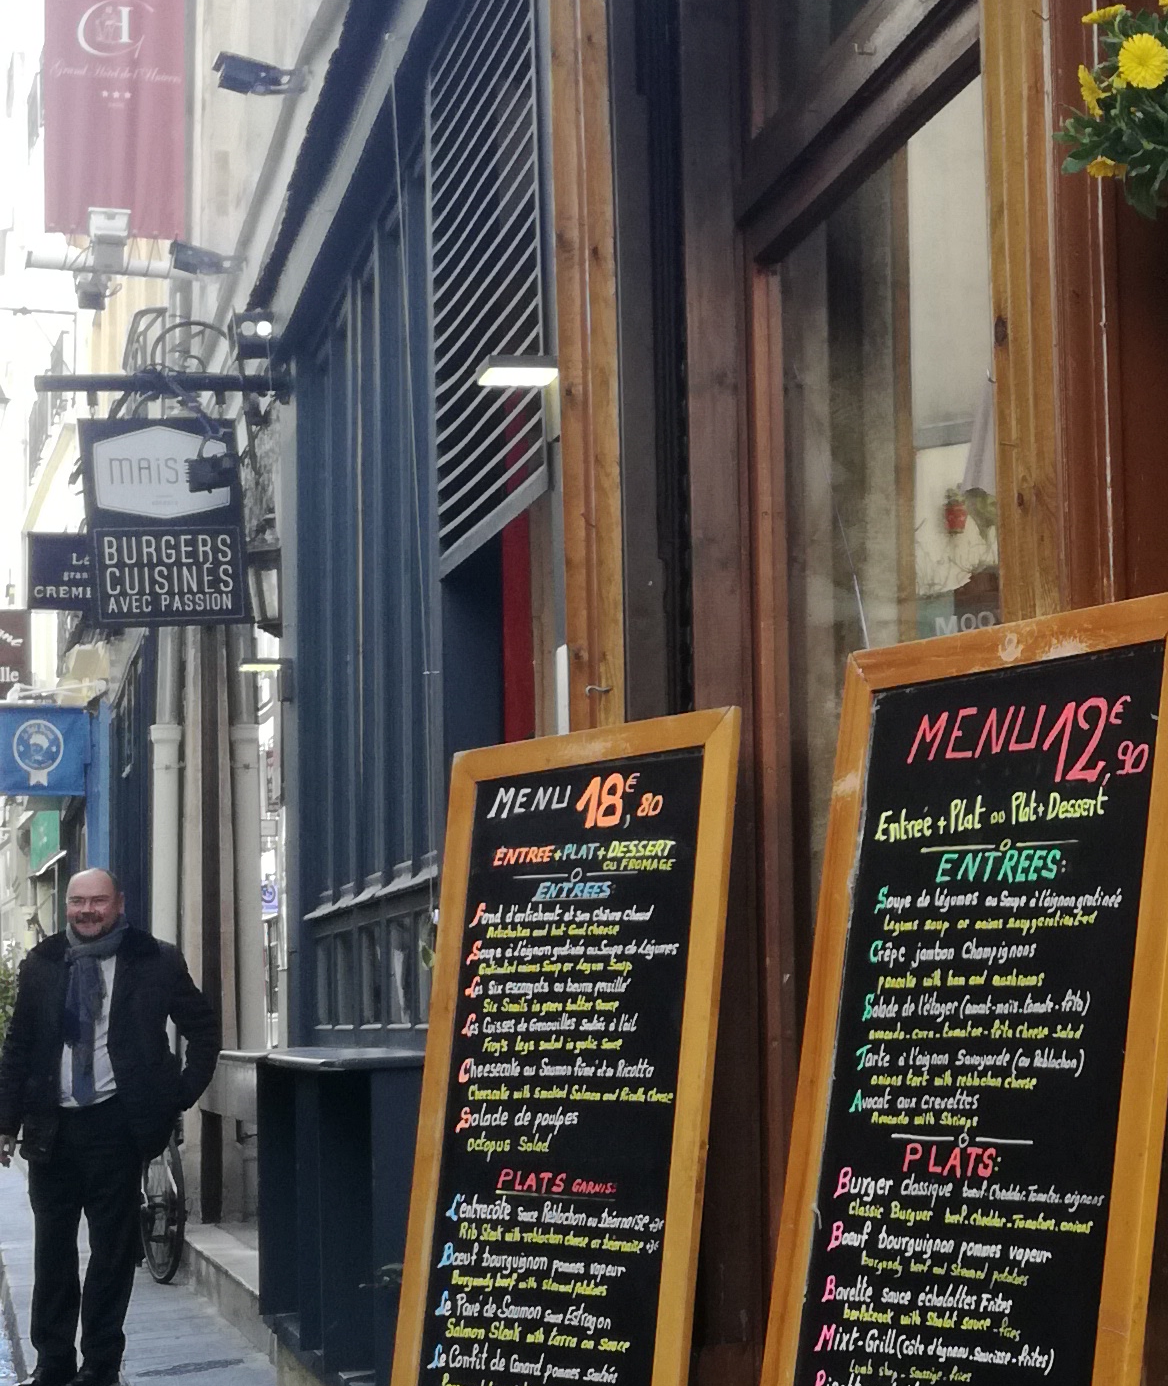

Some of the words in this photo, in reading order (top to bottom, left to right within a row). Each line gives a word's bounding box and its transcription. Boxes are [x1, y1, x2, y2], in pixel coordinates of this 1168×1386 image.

[104, 535, 231, 564] BURGERS
[108, 596, 152, 613] AVEC
[162, 593, 232, 611] PASSION
[907, 704, 1047, 765] MENU
[487, 785, 571, 819] MENU
[875, 806, 932, 843] Entrée
[950, 795, 985, 834] Plat
[620, 858, 676, 871] FROMAGE
[870, 940, 906, 968] Crêpe
[962, 938, 1037, 966] Champignons
[856, 1044, 891, 1071] Tarte
[849, 1089, 891, 1113] Avocat
[456, 1103, 508, 1133] Salade
[515, 1105, 531, 1126] de
[497, 1169, 567, 1193] PLATS
[833, 1167, 893, 1202] Burger
[878, 1225, 954, 1263] bourguignon
[1009, 1238, 1052, 1268] vapeur
[822, 1275, 873, 1303] Bavette
[881, 1288, 912, 1306] sauce
[449, 1342, 488, 1370] Confit
[490, 1349, 505, 1372] de
